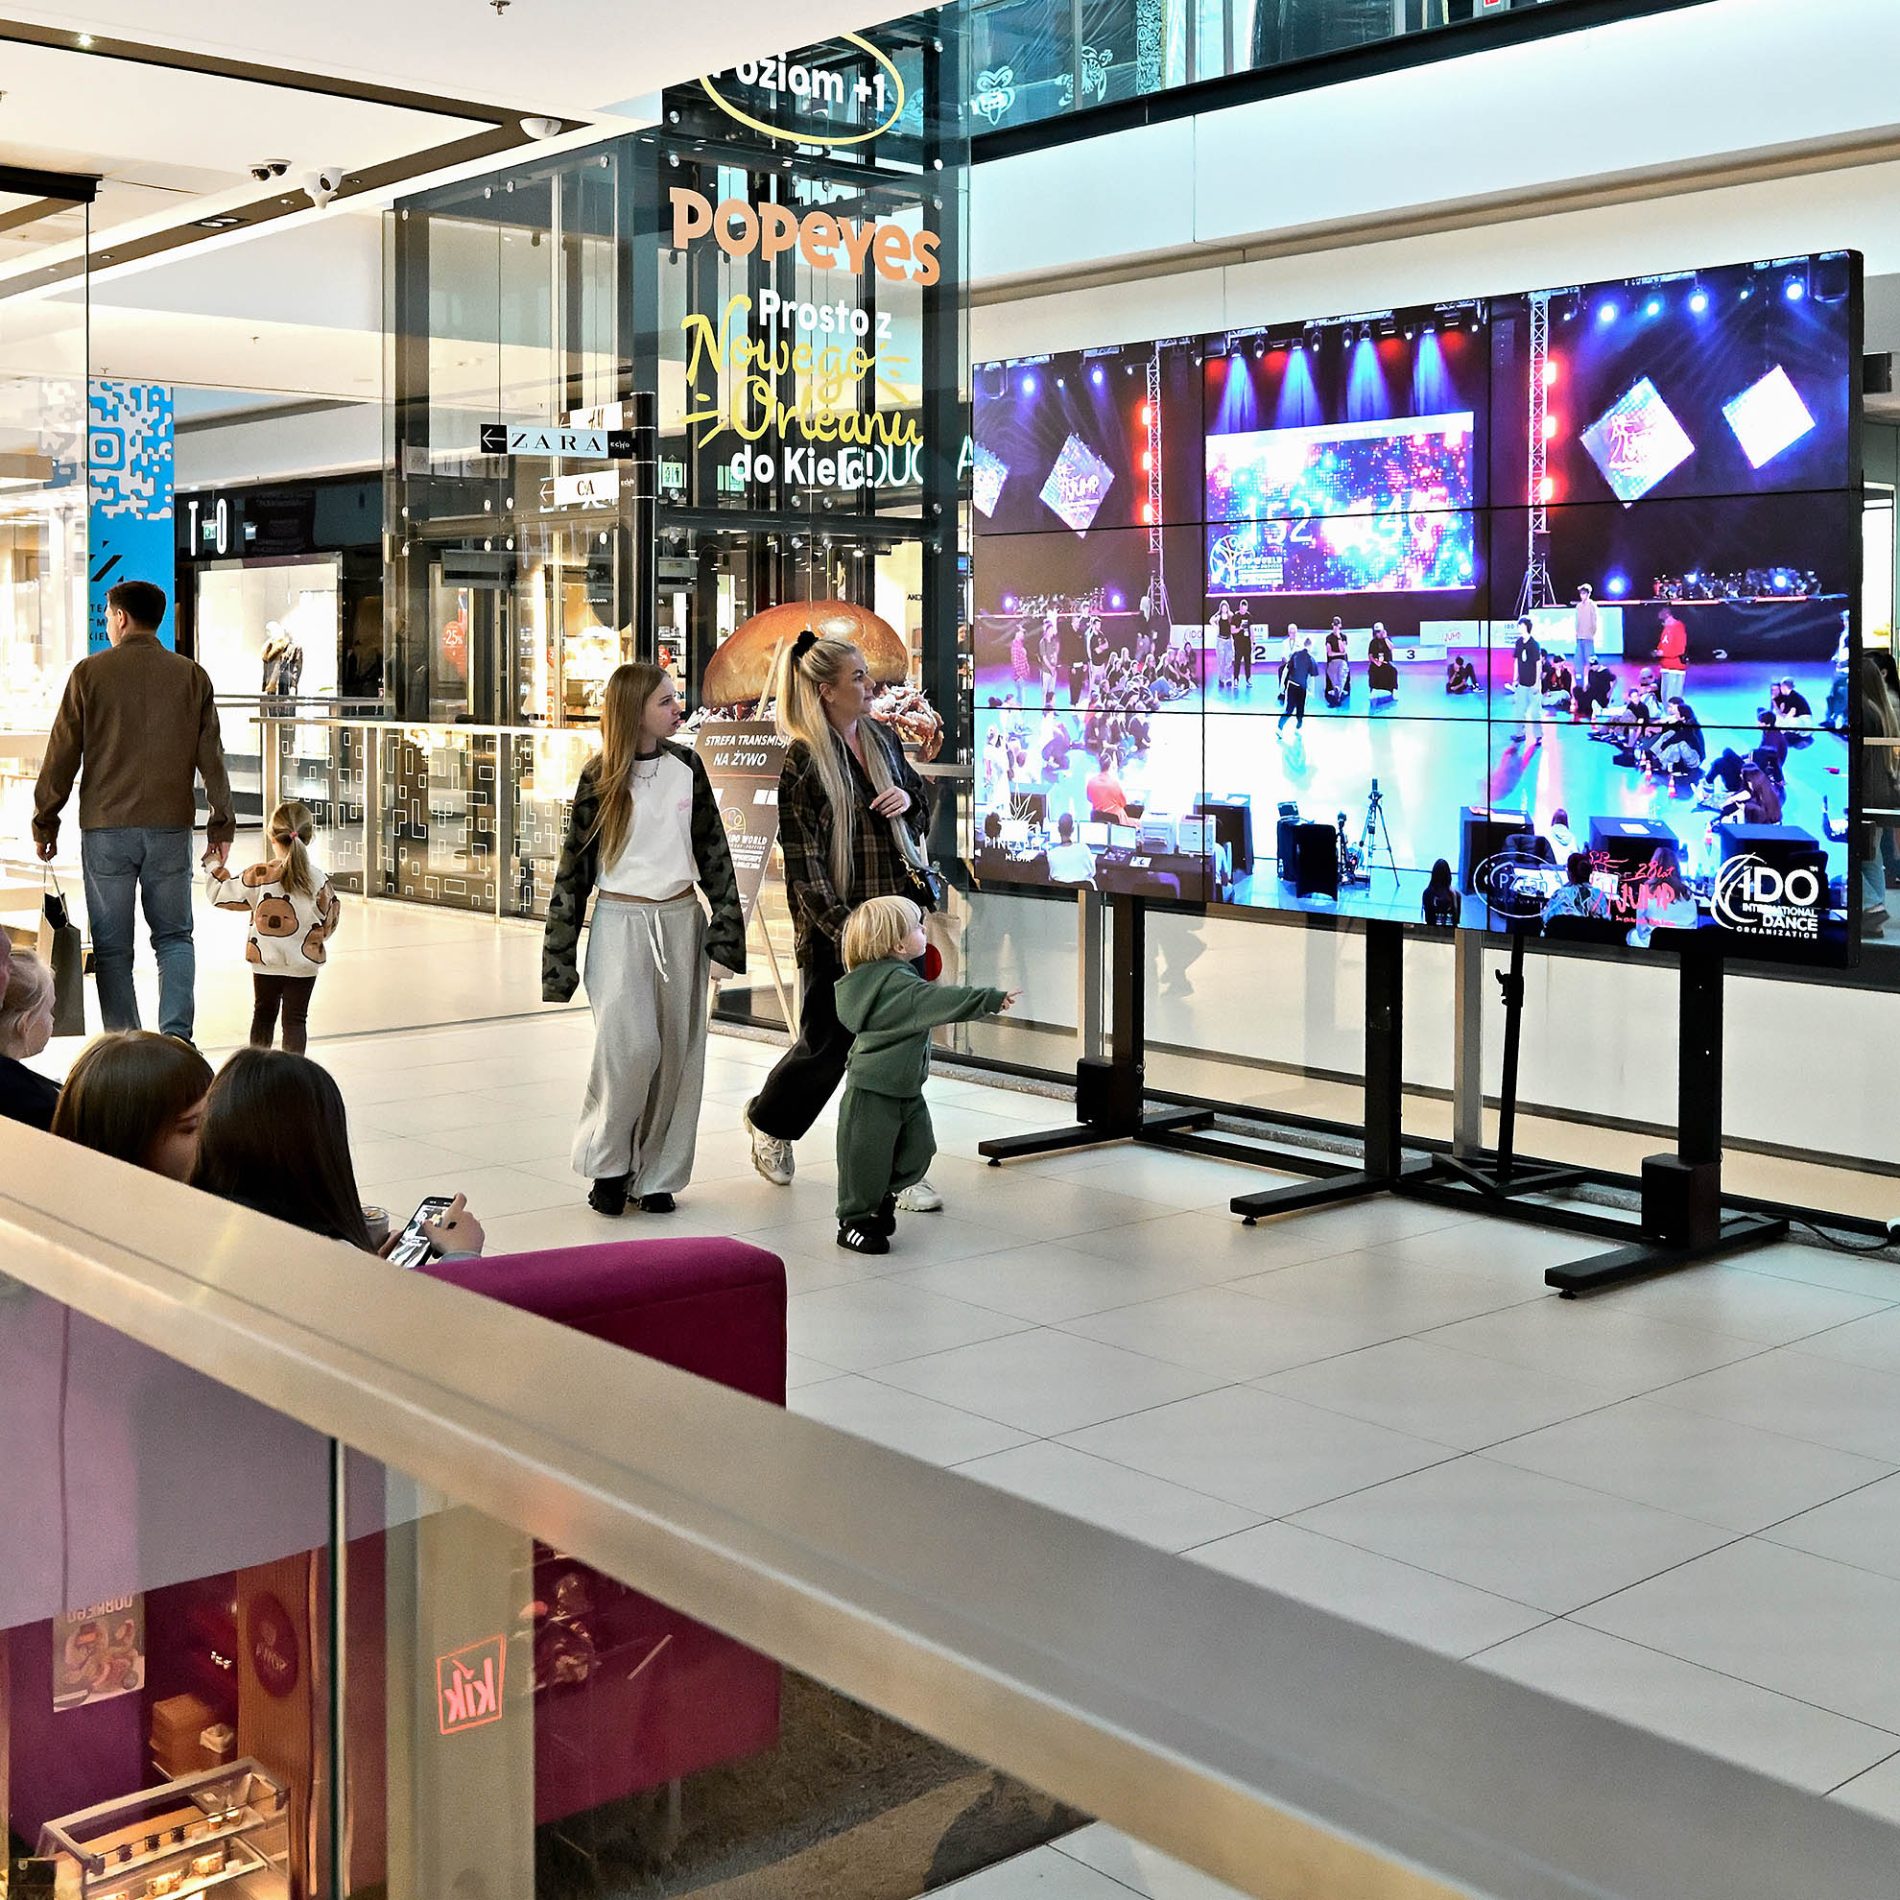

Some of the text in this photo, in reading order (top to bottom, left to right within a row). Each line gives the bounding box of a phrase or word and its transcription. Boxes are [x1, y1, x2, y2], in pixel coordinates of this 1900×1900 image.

[713, 52, 886, 112] oziom +1
[759, 288, 892, 339] Prosto z
[681, 294, 876, 404] Nowego
[731, 375, 924, 447] Orleanu
[511, 432, 604, 452] ZARA
[730, 445, 775, 484] do
[1255, 645, 1267, 660] 2
[1406, 649, 1416, 660] 3
[705, 735, 736, 746] STREFA
[713, 750, 768, 767] NA ŻYWO
[1742, 903, 1818, 918] INTERNATIONAL
[1736, 925, 1818, 939] ORGANIZATION
[1762, 914, 1818, 932] DANCE
